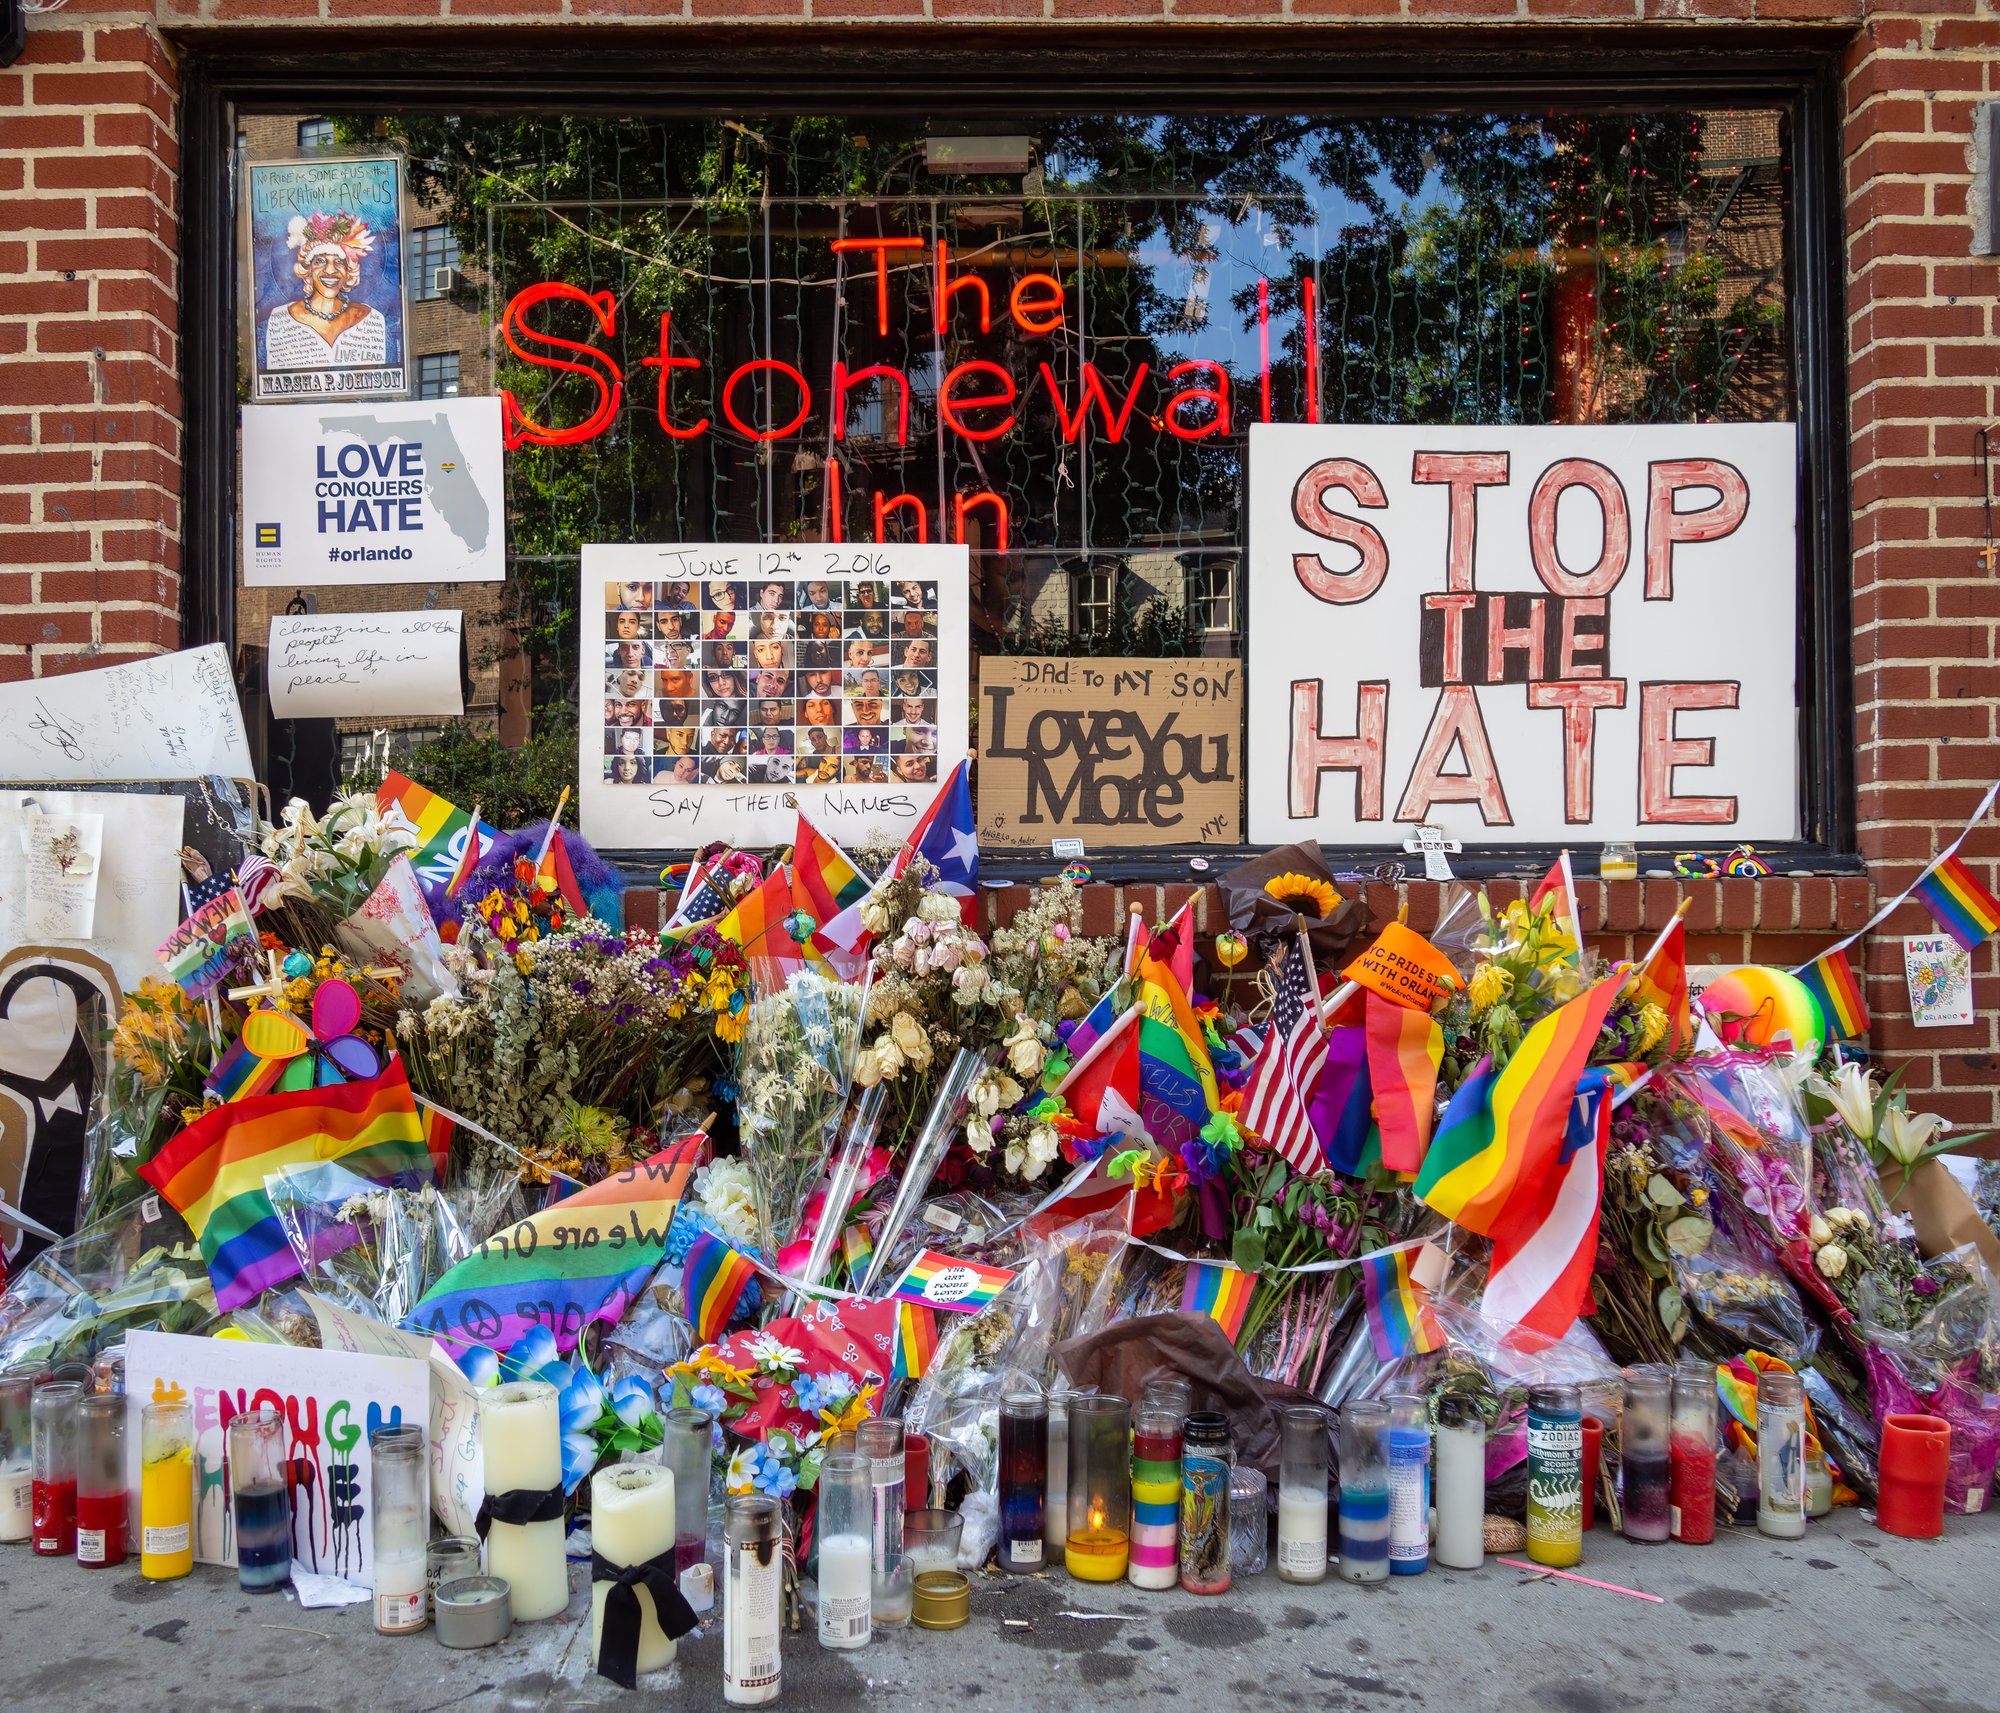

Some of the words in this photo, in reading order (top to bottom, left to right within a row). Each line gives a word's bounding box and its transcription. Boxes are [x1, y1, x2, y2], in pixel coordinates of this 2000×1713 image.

[308, 169, 339, 182] SOME
[372, 180, 392, 204] US
[831, 238, 1064, 337] The
[503, 276, 1318, 450] Stonewall
[262, 374, 321, 394] MARSHA
[325, 374, 335, 391] P.
[337, 370, 401, 390] JOHNSON
[316, 443, 423, 478] LOVE
[315, 479, 423, 498] CONQUERS
[825, 457, 1009, 553] Inn
[317, 497, 423, 533] HATE
[1291, 451, 1750, 605] STOP
[329, 545, 412, 562] #orlando
[658, 550, 738, 578] JUNE
[825, 552, 891, 575] 2016
[1425, 593, 1606, 683] THE
[1114, 669, 1154, 696] MY
[1171, 668, 1236, 701] SON
[1288, 678, 1741, 826] HATE
[648, 789, 705, 824] SAY
[823, 790, 918, 818] NAMES
[1019, 753, 1184, 828] More
[1200, 813, 1229, 842] NYC
[1369, 945, 1386, 958] YC
[1387, 952, 1426, 979] PRIDE
[1908, 940, 1944, 954] LOVE
[1363, 957, 1398, 981] WITH
[1399, 975, 1443, 1000] ORLAN
[1541, 1432, 1580, 1441] ZODIAC
